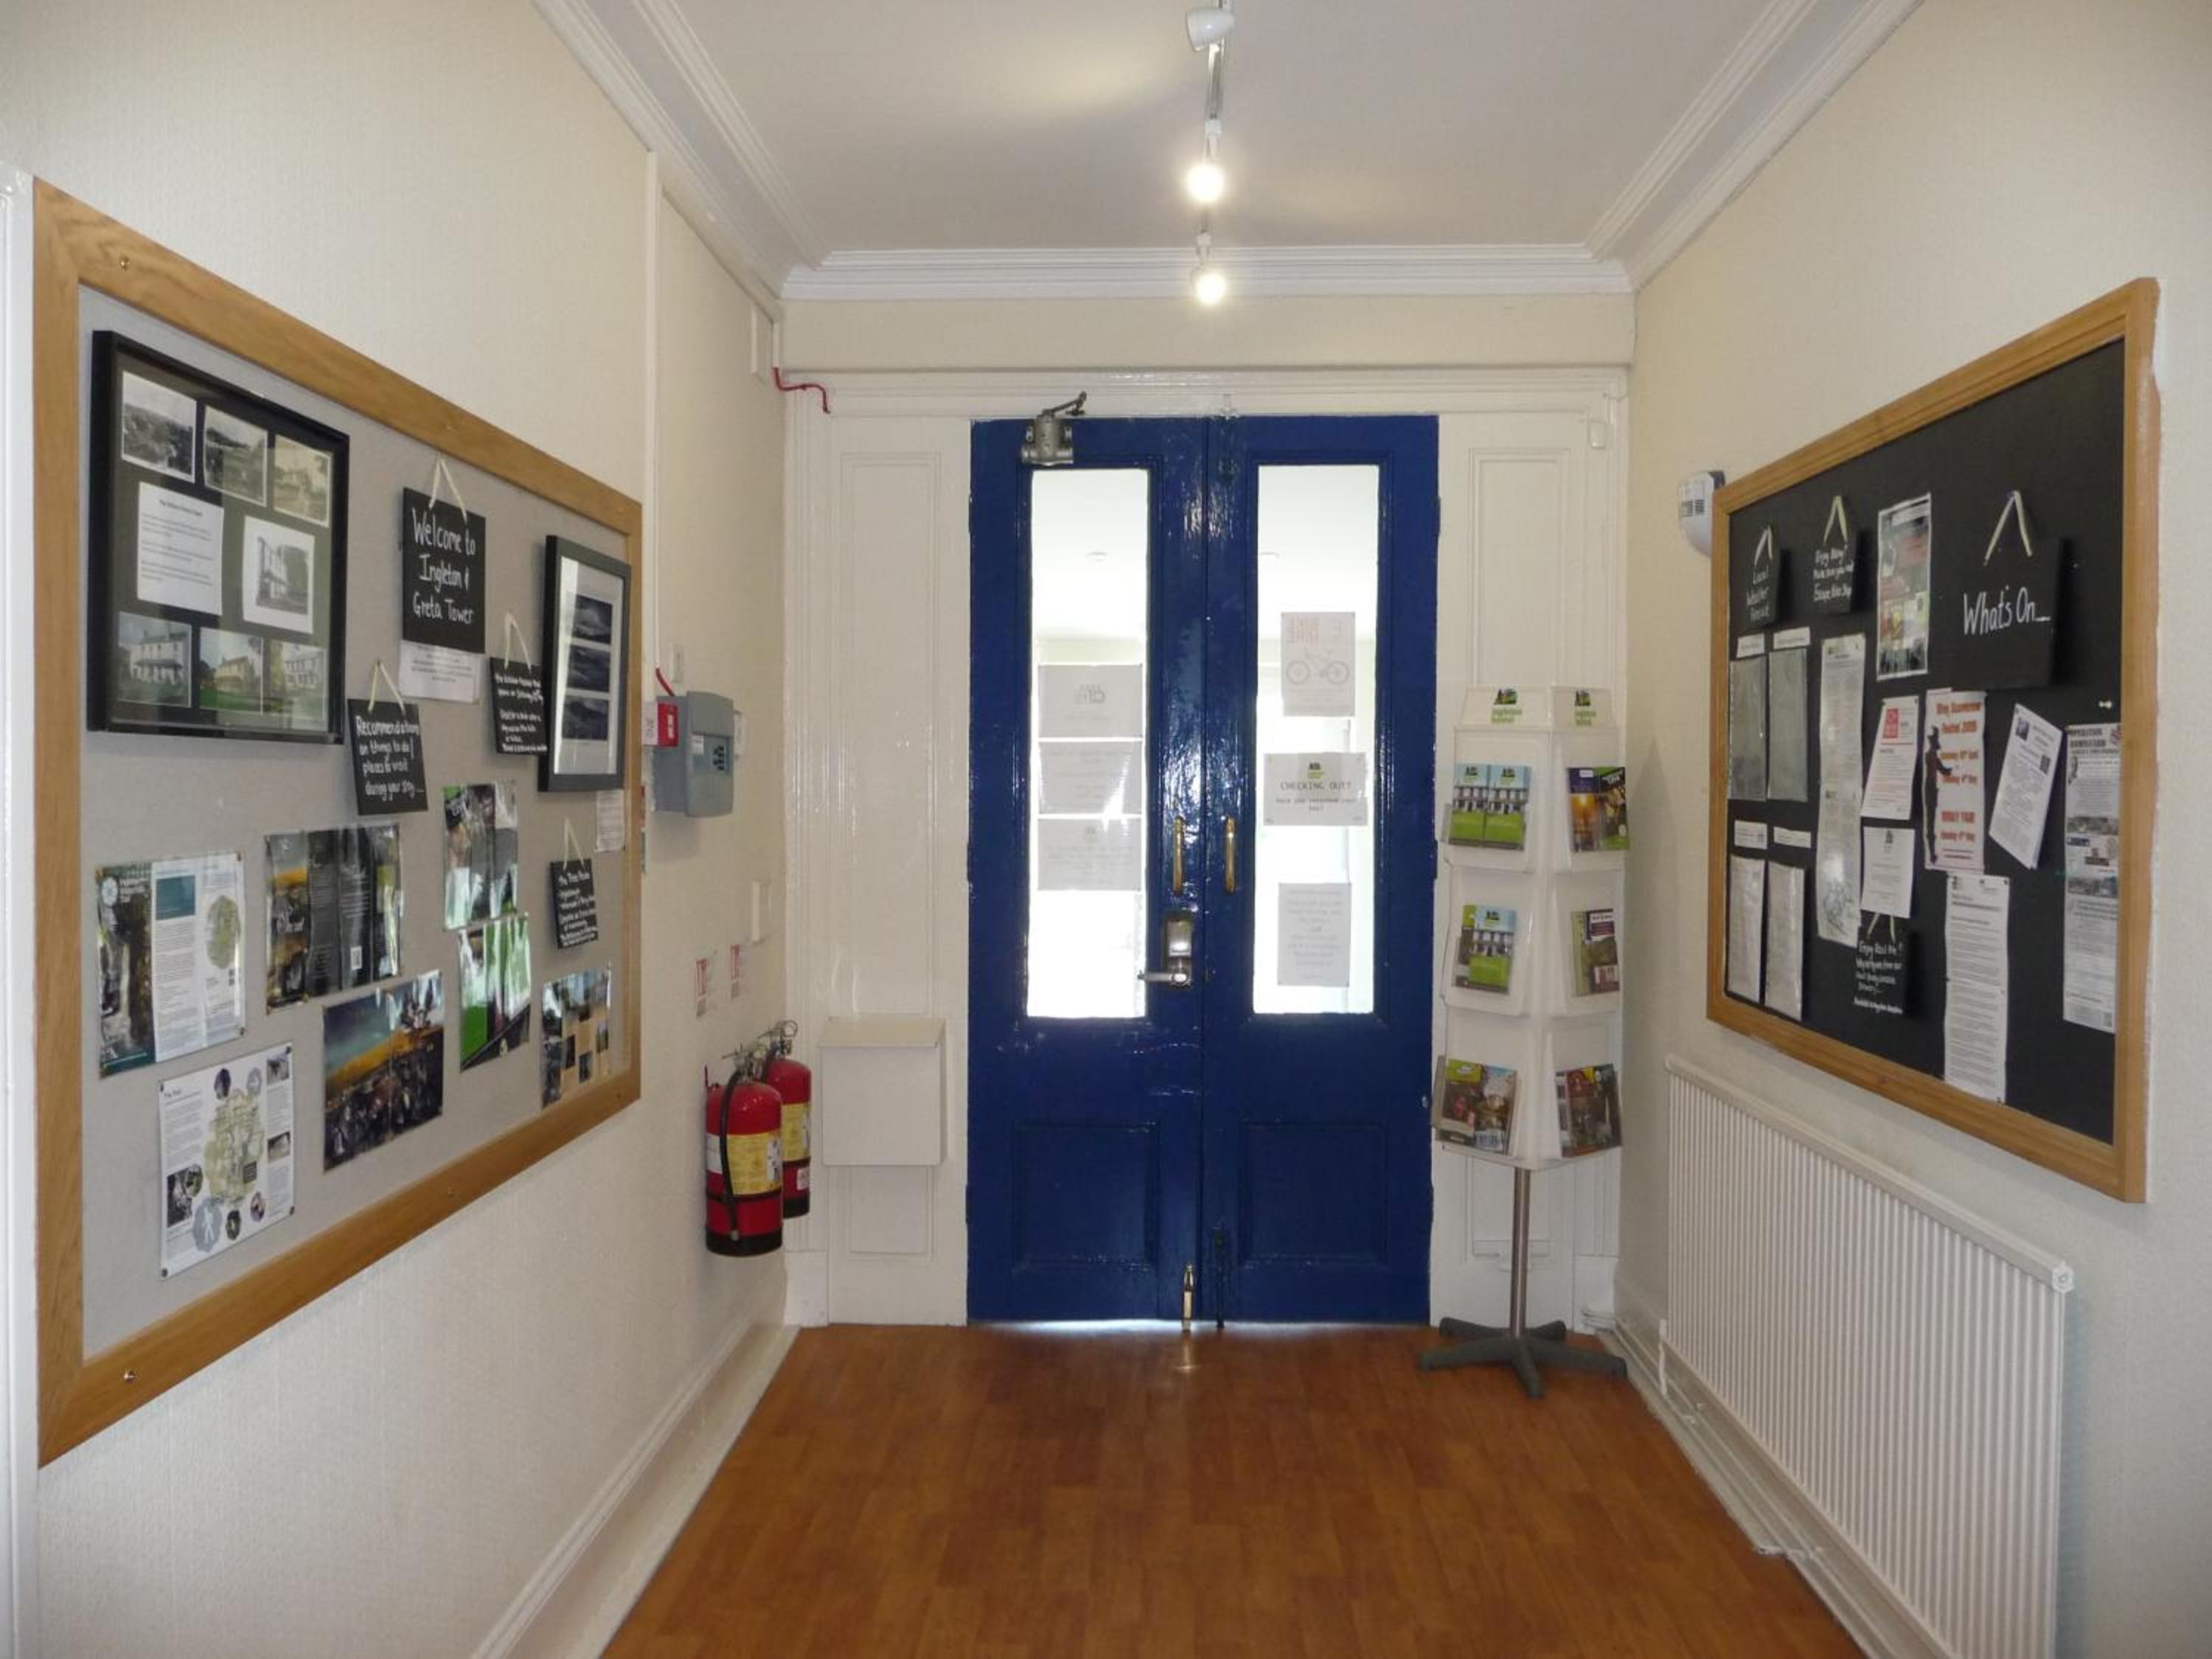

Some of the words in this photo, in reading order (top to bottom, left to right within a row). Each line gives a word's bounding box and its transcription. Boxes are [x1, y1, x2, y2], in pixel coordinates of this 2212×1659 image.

[411, 507, 462, 553] Welcome
[465, 528, 476, 555] to
[412, 591, 442, 619] Greta
[444, 598, 474, 625] Tower
[1964, 584, 2012, 635] What's
